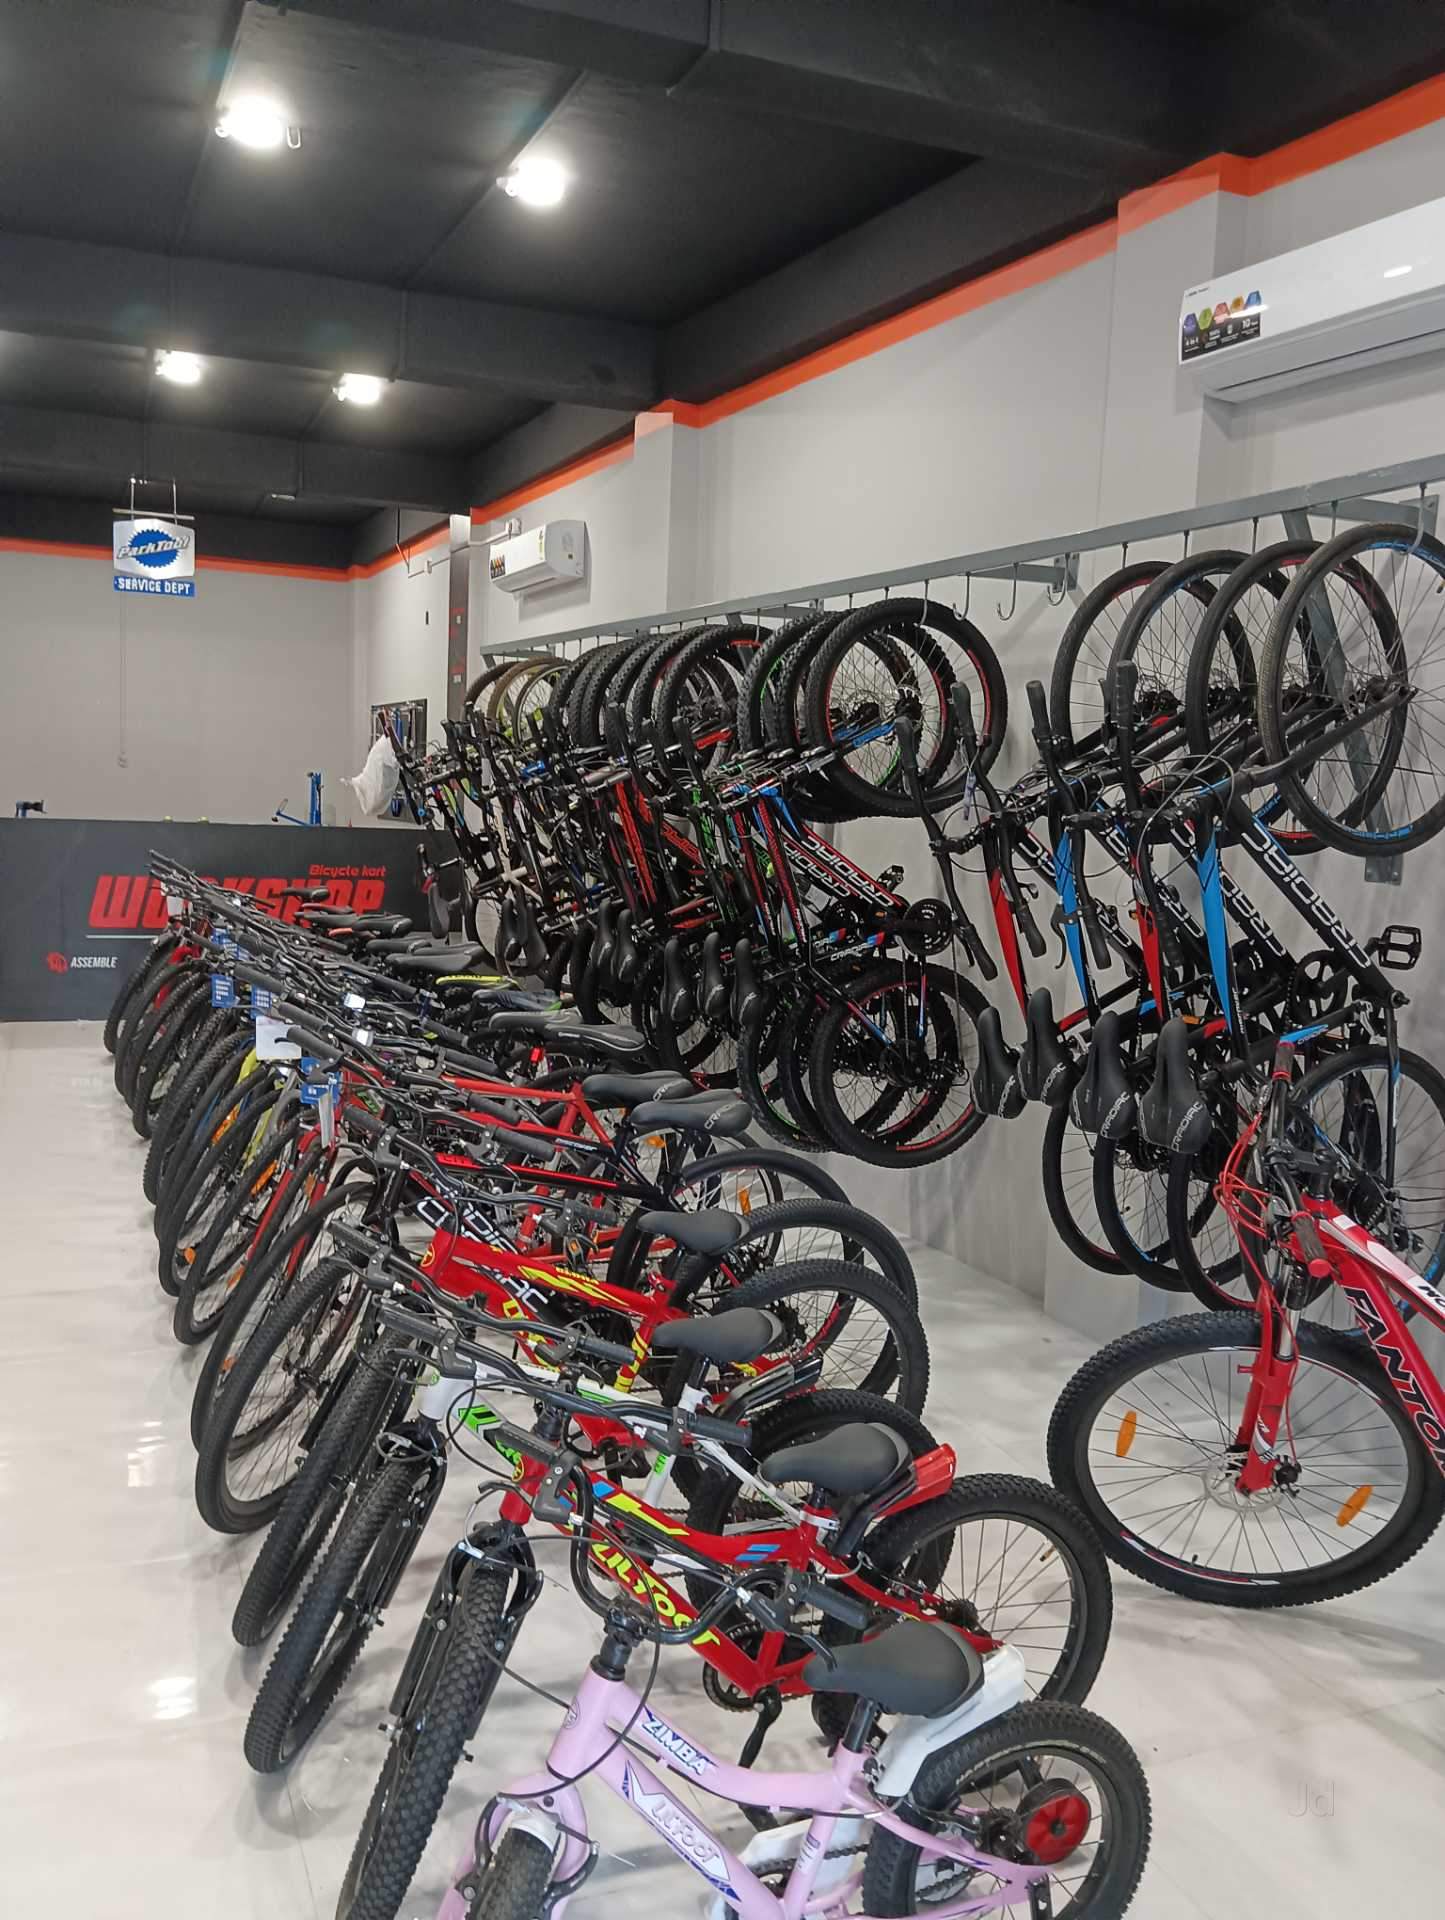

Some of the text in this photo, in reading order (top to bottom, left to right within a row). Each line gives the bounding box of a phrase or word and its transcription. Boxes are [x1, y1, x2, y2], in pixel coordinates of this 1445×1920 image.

[117, 577, 191, 595] SERVICE DEPT
[309, 864, 359, 878] Bicycle
[784, 842, 851, 897] CRADIA
[801, 835, 894, 907] CRADIAC
[1170, 822, 1287, 957] CRADC
[1241, 822, 1371, 968] CRADIAC
[89, 874, 385, 928] WOSHOP
[70, 956, 118, 969] ASSEMBLE
[642, 1718, 709, 1777] ZIMBA
